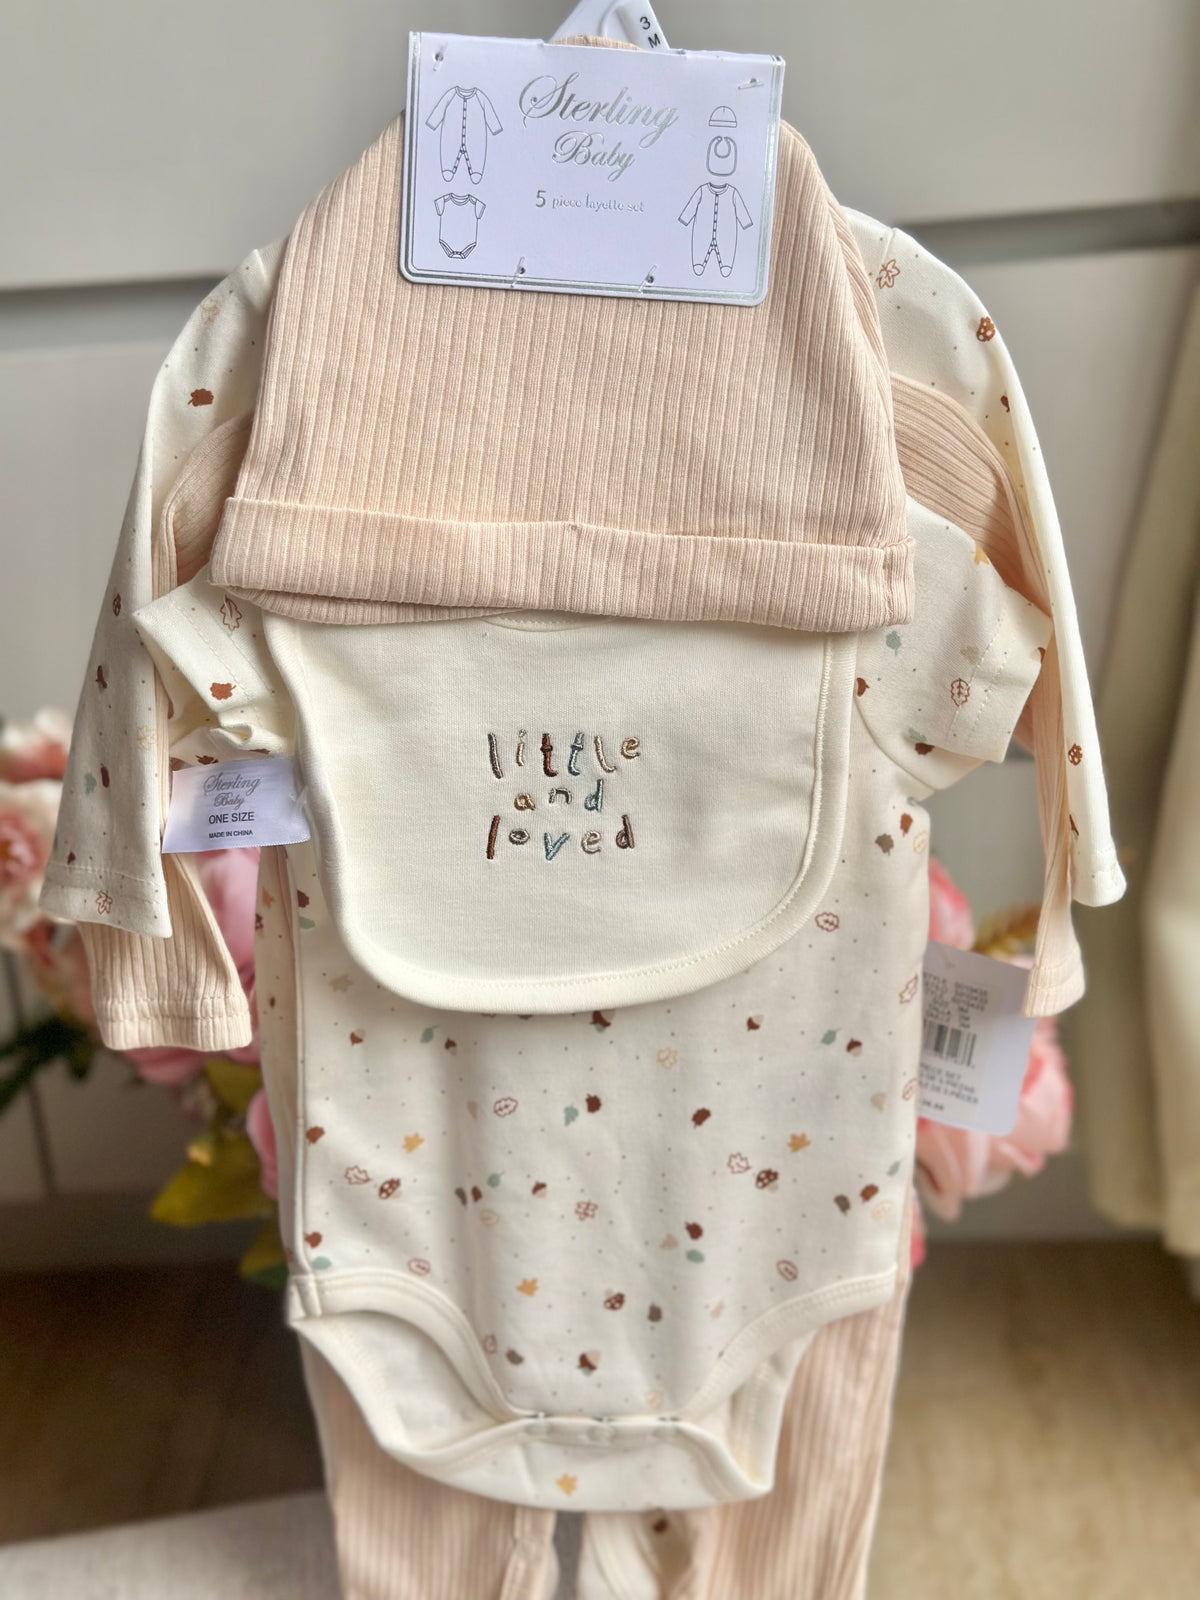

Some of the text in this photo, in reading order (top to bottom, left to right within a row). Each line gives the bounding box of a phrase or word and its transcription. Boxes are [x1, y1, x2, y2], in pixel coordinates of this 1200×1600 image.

[640, 16, 651, 30] 3
[648, 34, 661, 48] M
[519, 72, 679, 149] Sterling
[552, 131, 635, 182] Baby
[535, 190, 645, 213] 5 piece layette set
[488, 729, 641, 779] little
[203, 772, 262, 796] Sterling
[514, 779, 604, 812] and
[213, 792, 245, 810] Baby
[208, 811, 255, 825] ONE SIZE
[233, 829, 254, 837] CHINA
[486, 815, 635, 861] loved
